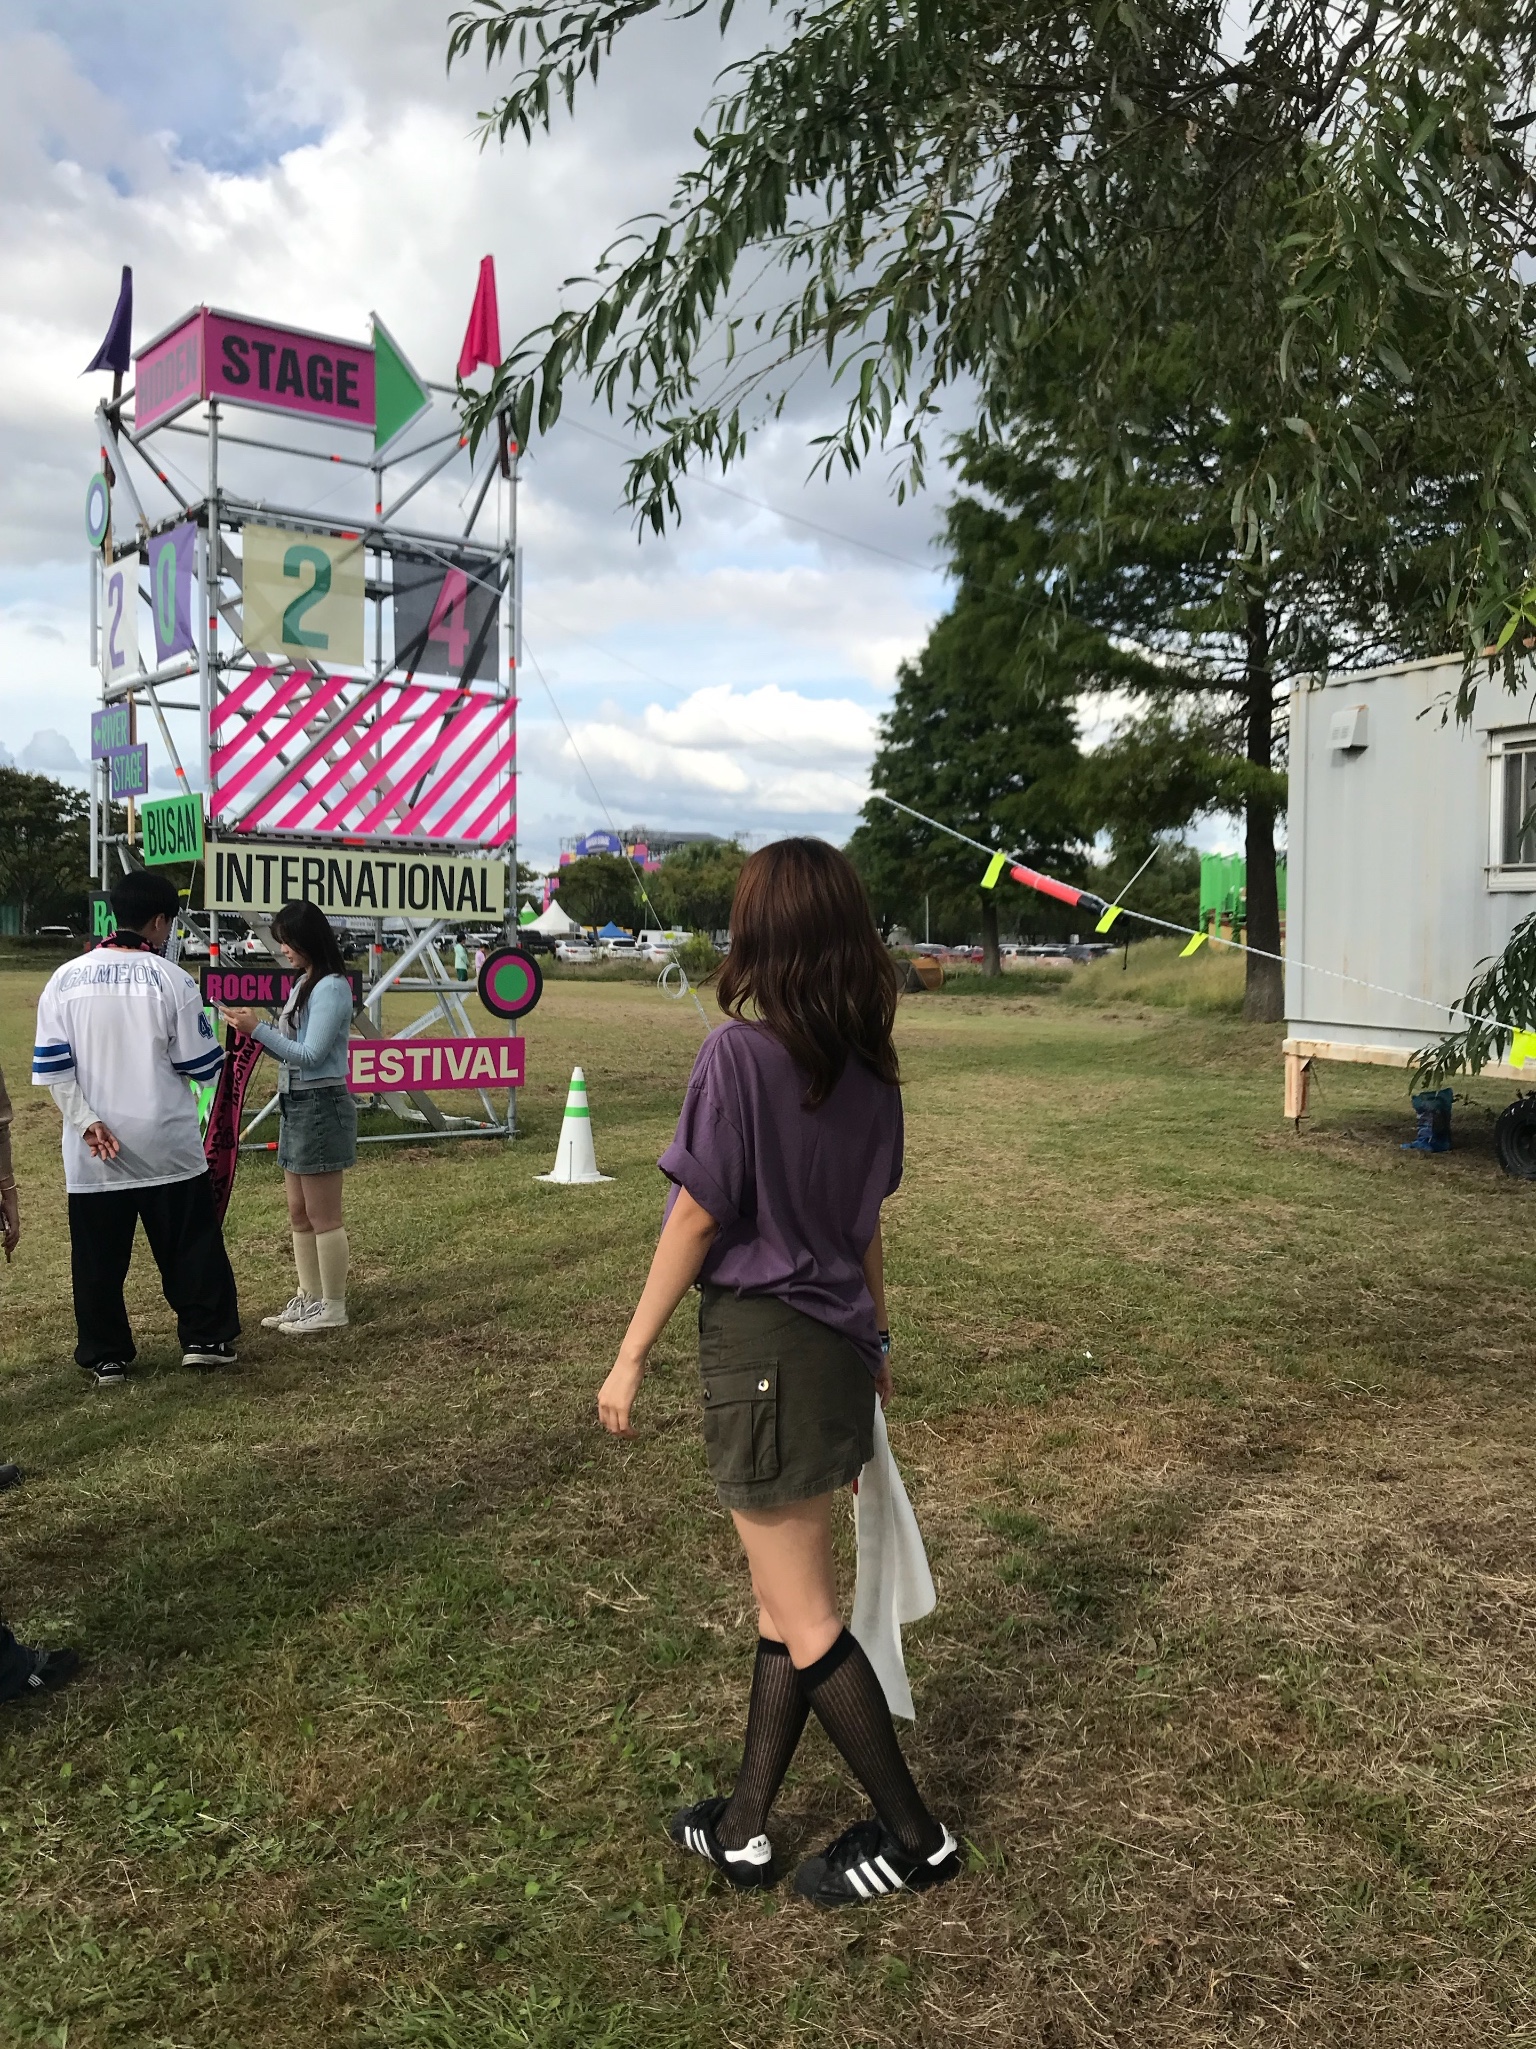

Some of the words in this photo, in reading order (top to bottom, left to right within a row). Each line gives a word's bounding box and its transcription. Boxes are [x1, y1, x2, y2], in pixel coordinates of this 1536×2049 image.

[138, 334, 198, 417] HIDDEN
[222, 335, 359, 408] STAGE
[108, 571, 125, 669] 2
[156, 542, 176, 647] 0
[282, 544, 332, 650] 2
[428, 567, 469, 667] 4
[101, 710, 128, 751] RIVER
[114, 751, 143, 792] STAGE
[147, 803, 197, 857] BUSAN
[215, 851, 497, 914] INTERNATIONAL
[60, 963, 130, 992] GAME
[134, 964, 163, 993] ON
[206, 974, 273, 1001] ROCK
[348, 1046, 519, 1084] ESTIVAL
